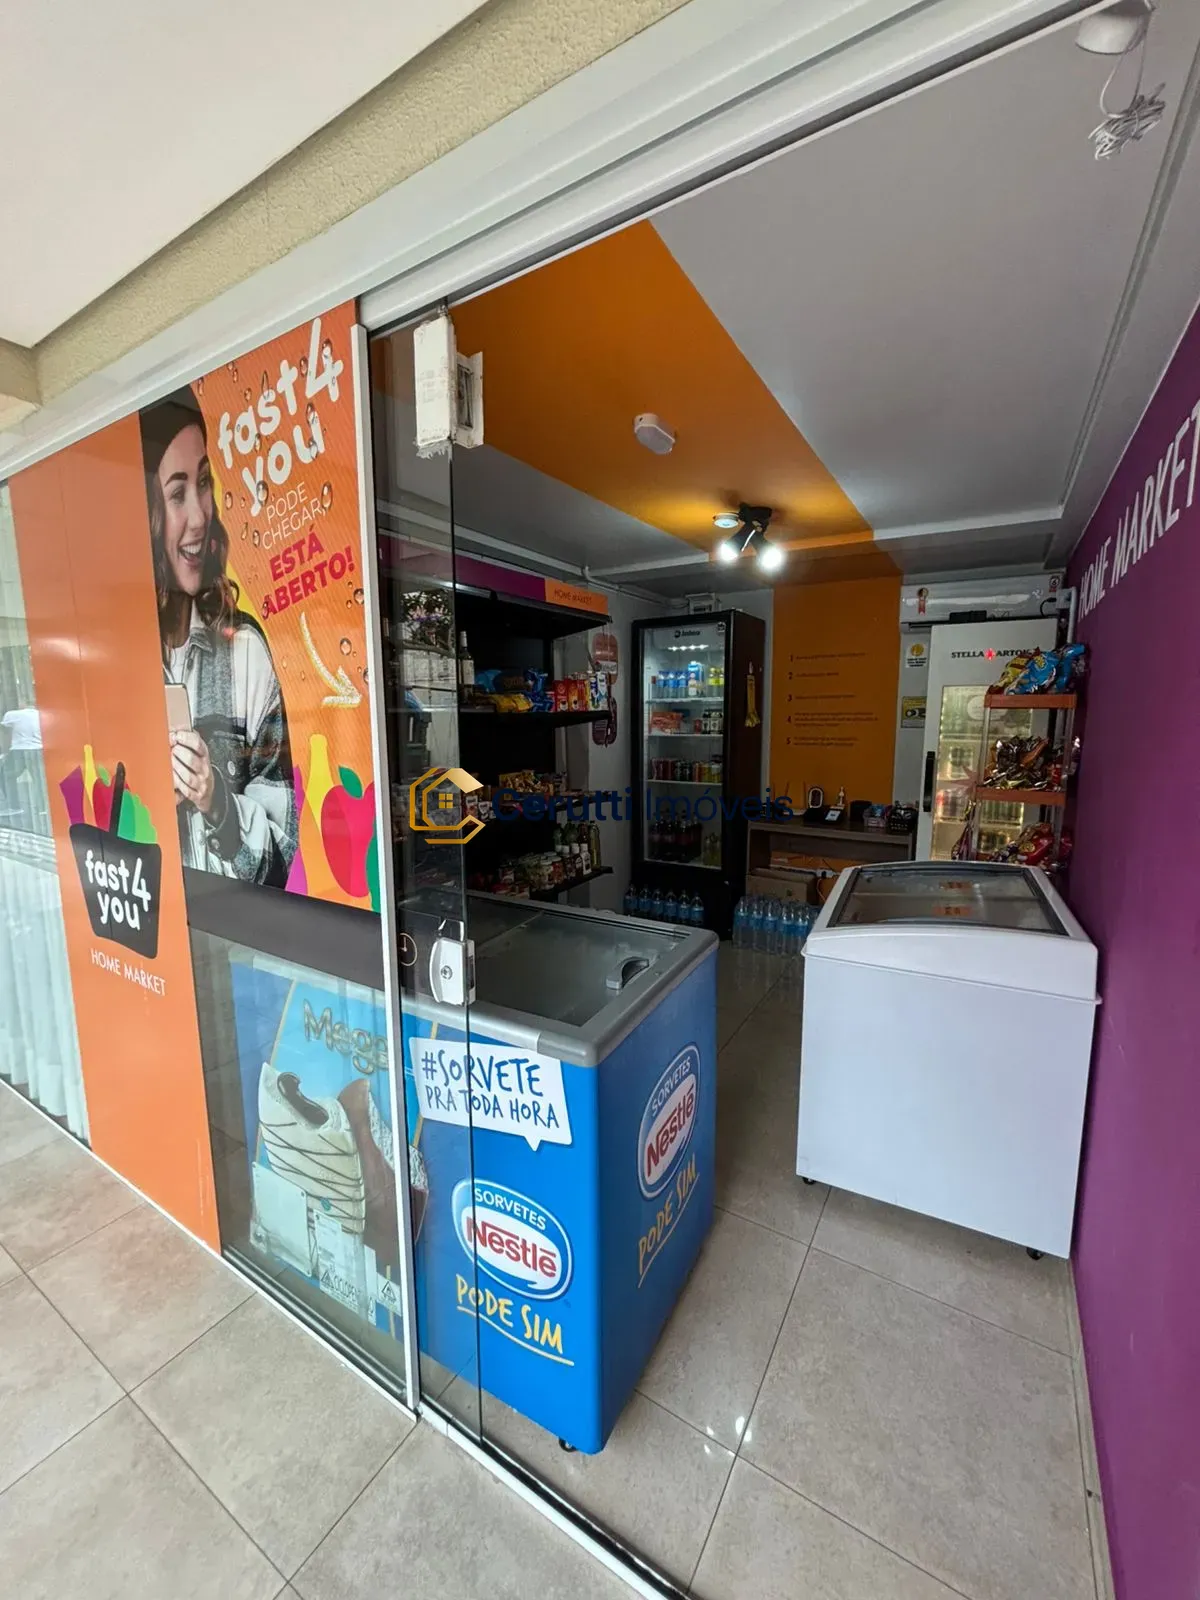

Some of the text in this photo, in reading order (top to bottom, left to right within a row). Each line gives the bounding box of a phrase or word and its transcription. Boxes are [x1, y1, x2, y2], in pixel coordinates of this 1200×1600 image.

[242, 410, 325, 517] you
[266, 481, 308, 524] PODE
[269, 523, 324, 581] ESTÁ
[262, 545, 355, 619] ABERTO!
[1078, 536, 1111, 622] HOME
[951, 651, 985, 659] STELLA
[97, 891, 140, 930] you
[91, 947, 166, 996] HOME MARKET
[421, 1049, 544, 1097] #SORVETE
[651, 1057, 692, 1118] SORVETES
[425, 1085, 560, 1129] PRA TODA HORA
[474, 1187, 547, 1231] SORVETES
[638, 1153, 696, 1274] PODE SIM
[455, 1273, 563, 1354] PODE SIM
